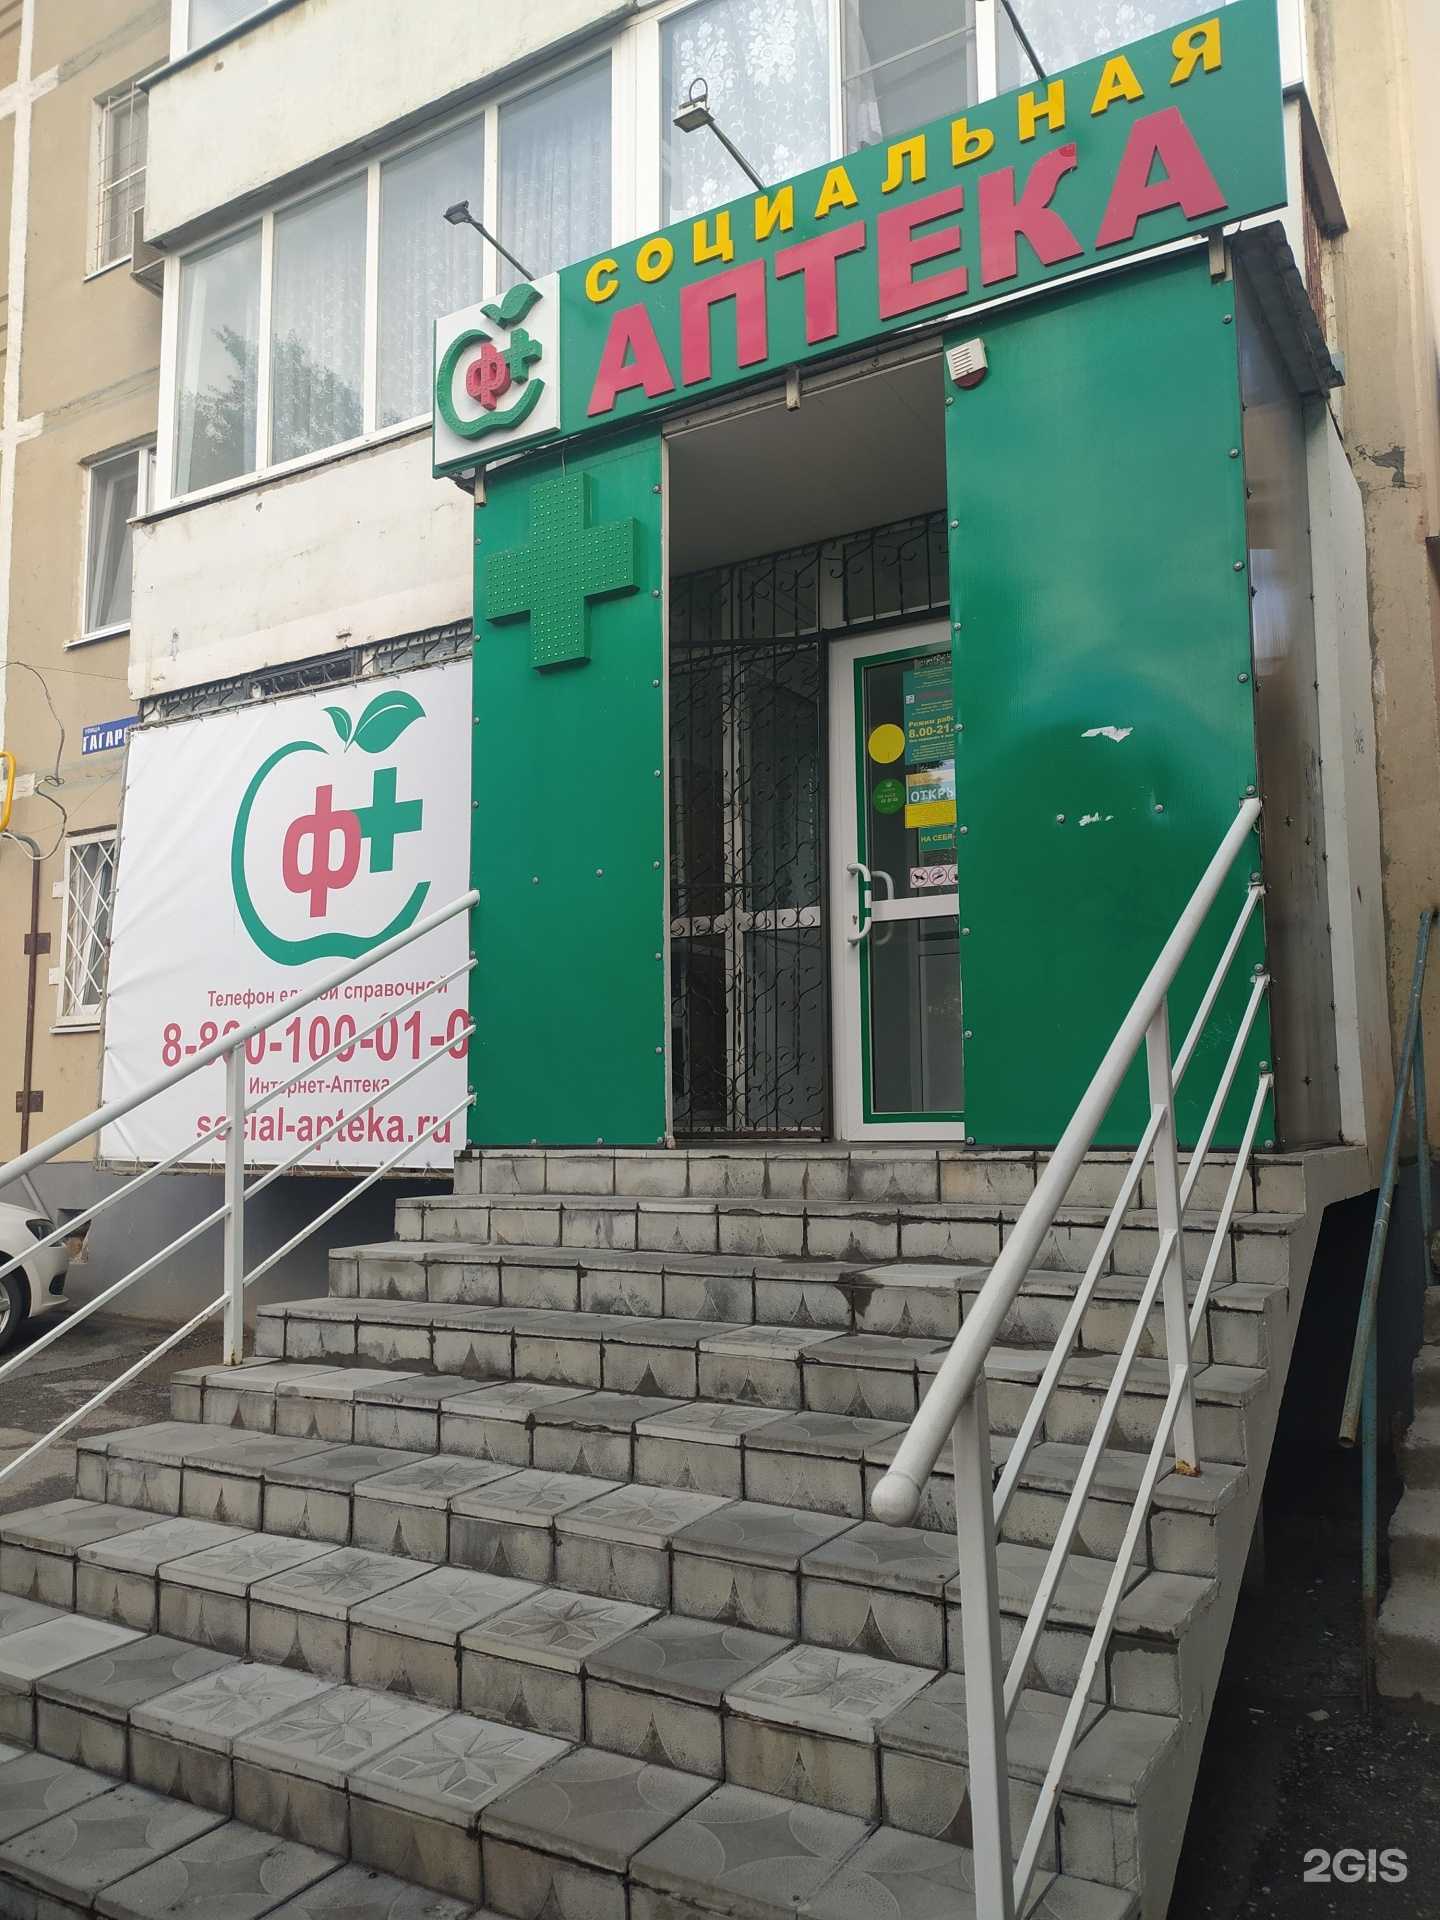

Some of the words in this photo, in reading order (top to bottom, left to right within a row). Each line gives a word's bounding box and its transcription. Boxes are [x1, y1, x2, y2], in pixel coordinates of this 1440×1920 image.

[585, 18, 1223, 304] СОЦИАЛЬНАЯ
[587, 105, 1229, 418] АПТЕКА
[207, 988, 275, 1009] Телефон
[280, 986, 339, 1002] еой
[249, 1075, 390, 1098] Интрнет-Аптека
[197, 1106, 451, 1151] sial-apteka.ru
